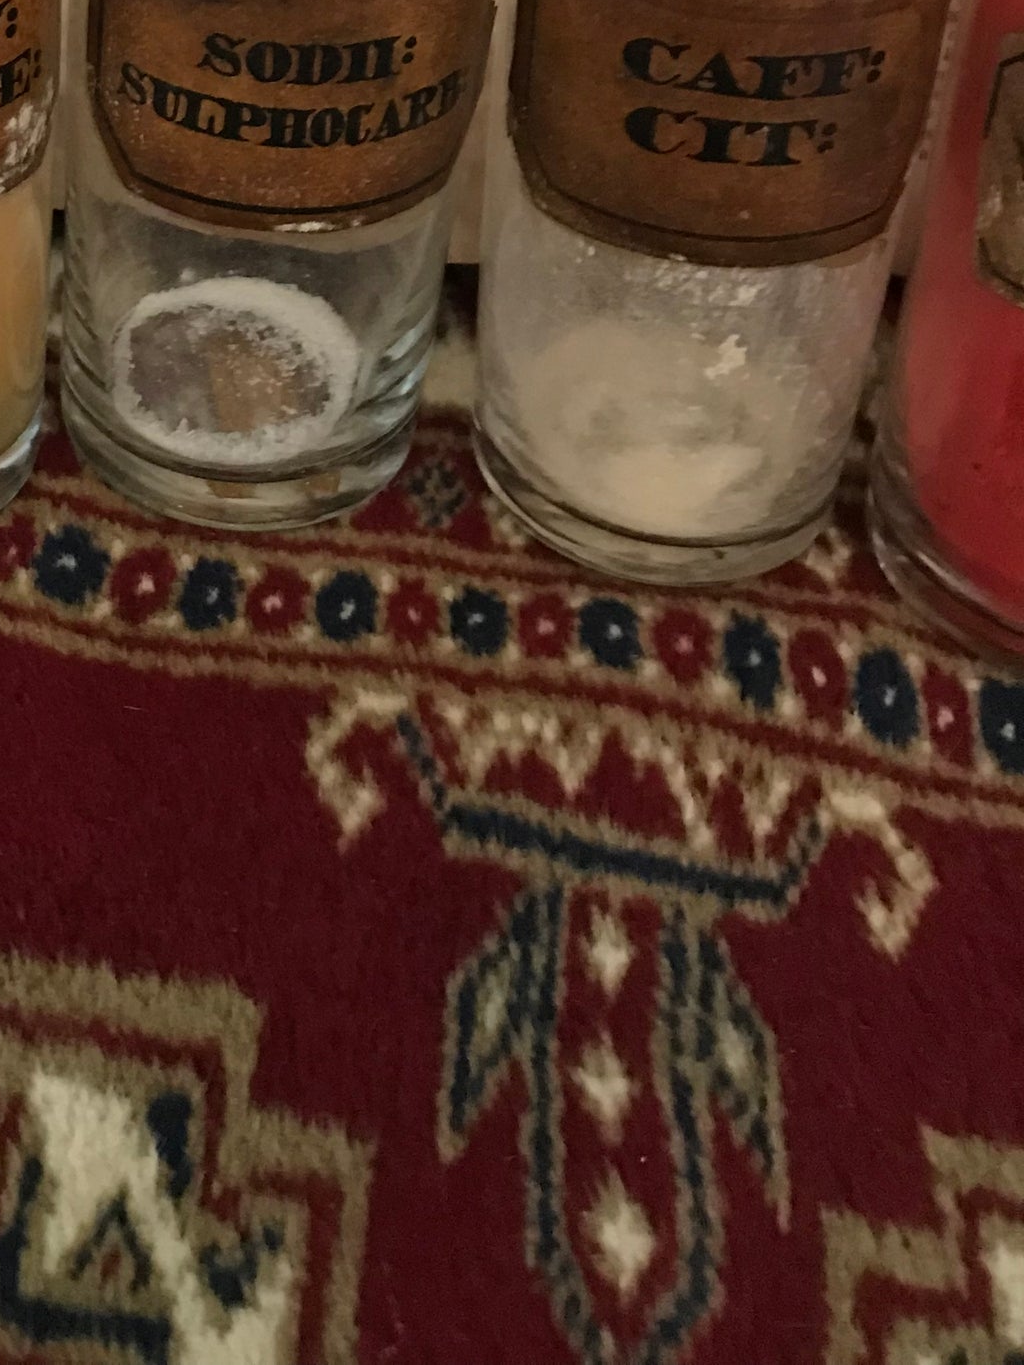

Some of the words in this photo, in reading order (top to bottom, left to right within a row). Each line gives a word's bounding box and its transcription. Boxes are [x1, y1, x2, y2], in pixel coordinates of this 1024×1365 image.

[198, 32, 417, 86] SODII:
[622, 37, 886, 101] CAFF:
[624, 106, 839, 167] CIT:
